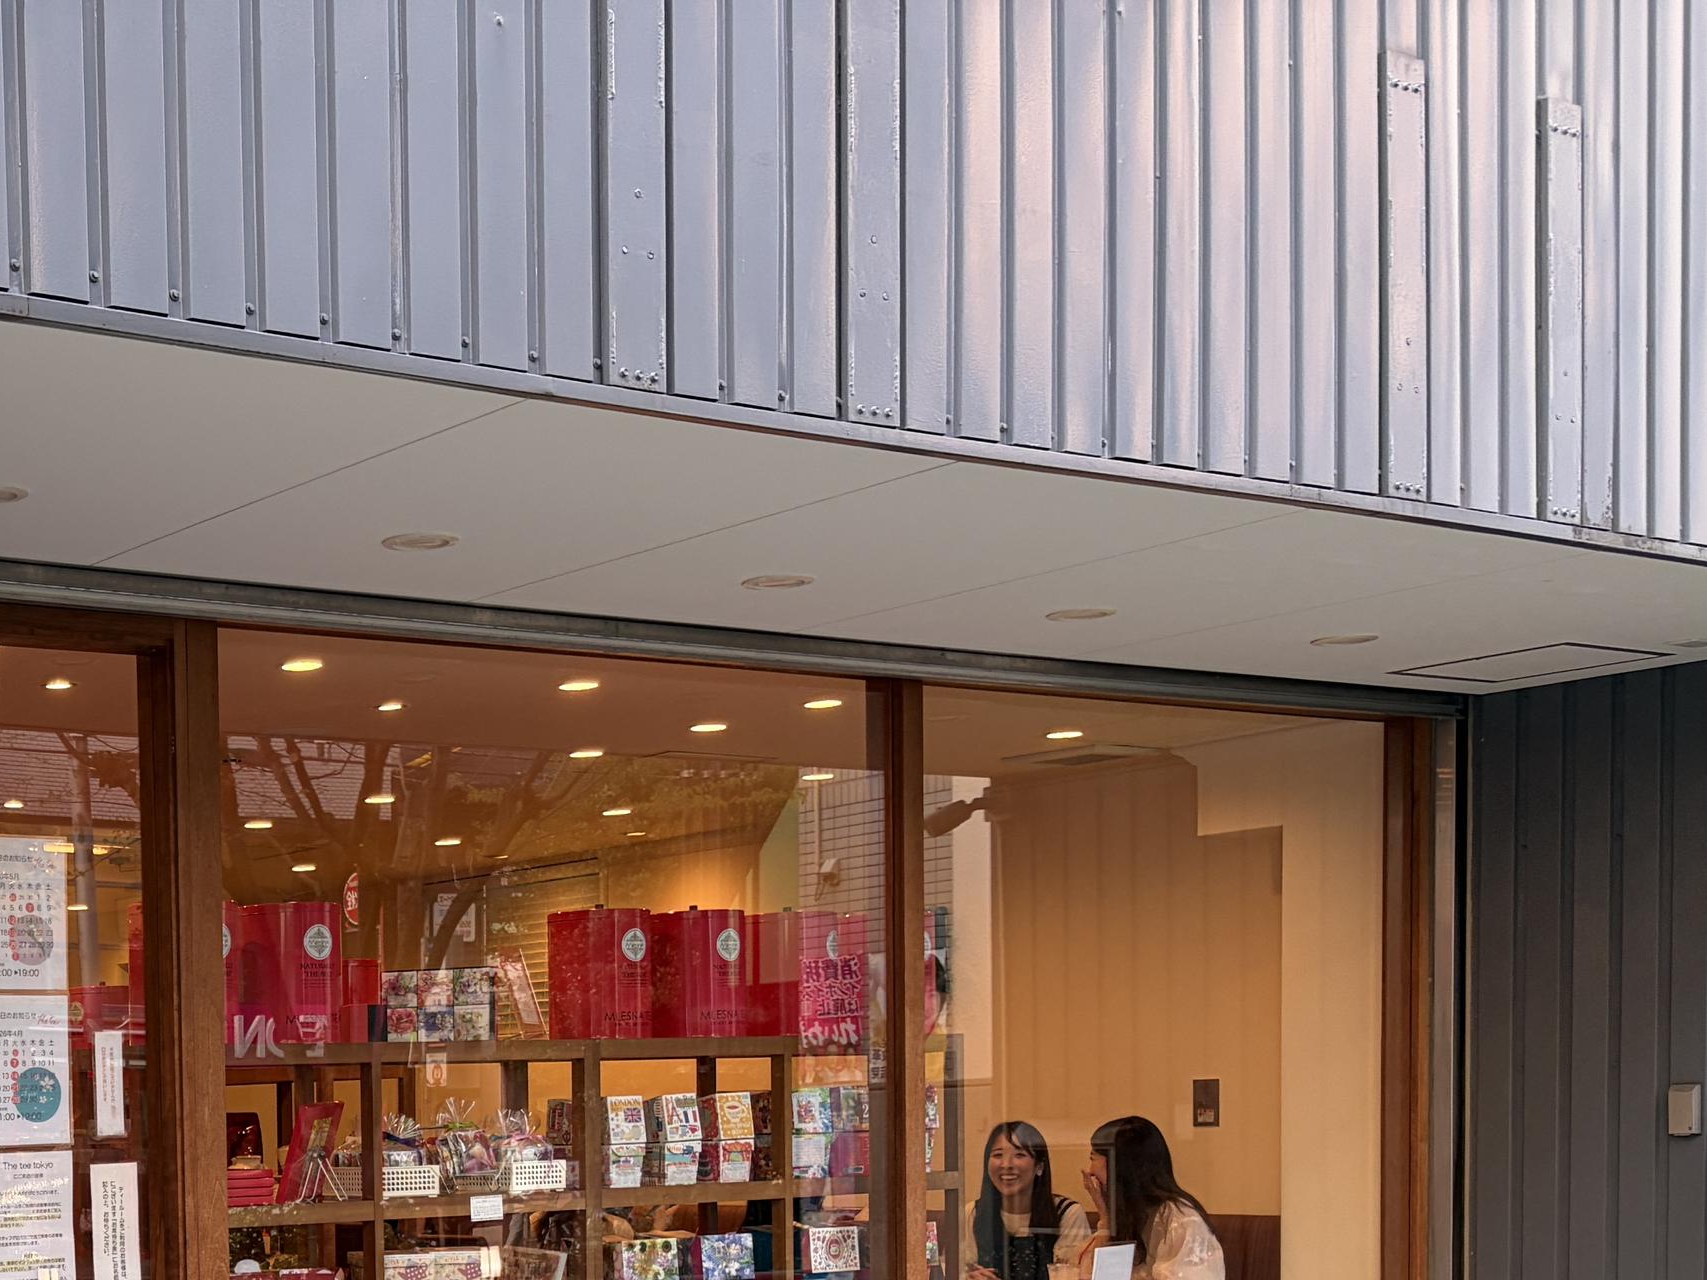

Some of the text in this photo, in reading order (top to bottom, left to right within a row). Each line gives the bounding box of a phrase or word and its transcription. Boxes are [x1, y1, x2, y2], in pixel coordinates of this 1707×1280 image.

[18, 969, 39, 977] 19:00
[2, 1161, 54, 1170] The tee tokyo
